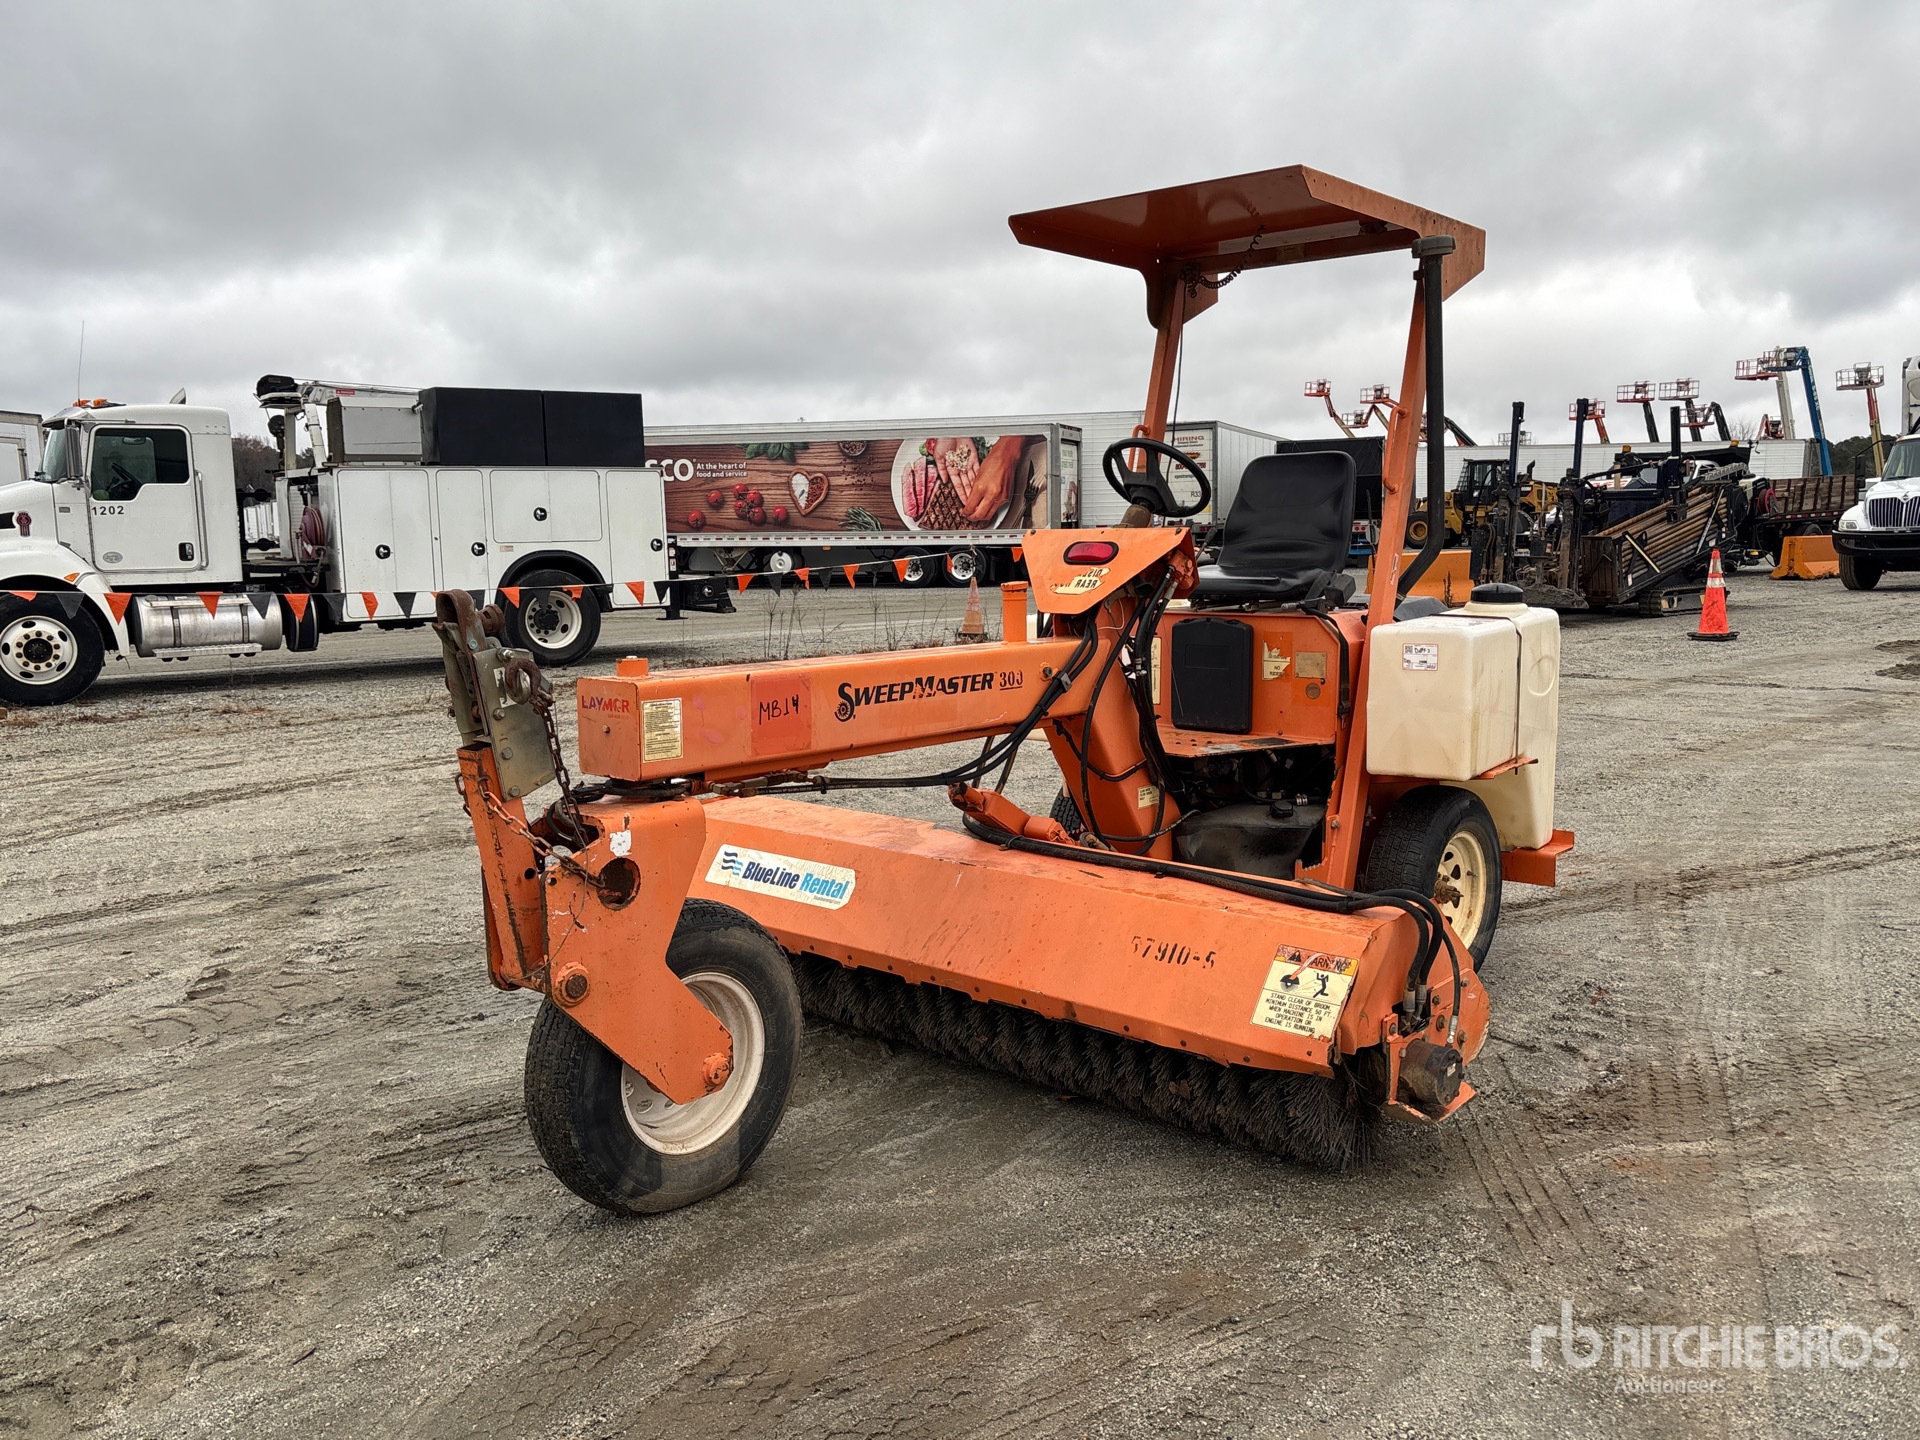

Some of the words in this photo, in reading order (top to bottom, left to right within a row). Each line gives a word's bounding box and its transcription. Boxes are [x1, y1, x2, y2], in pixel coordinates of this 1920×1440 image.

[718, 462, 738, 470] heart
[739, 461, 747, 469] of
[91, 505, 125, 516] 1202
[742, 861, 800, 889] BlueLine
[799, 872, 850, 899] Rental
[1270, 992, 1287, 1001] STAND
[1288, 995, 1304, 1004] CLEAR
[1305, 998, 1312, 1006] OF
[1265, 998, 1287, 1008] MINIMUM
[1288, 1002, 1313, 1013] DISTANCE
[1315, 1007, 1322, 1016] 50
[1269, 1005, 1282, 1013] WHEN
[1283, 1008, 1305, 1019] MACHINE
[1307, 1012, 1314, 1020] IS
[1316, 1014, 1323, 1022] IN
[1265, 1017, 1283, 1027] ENGINE
[1285, 1020, 1292, 1028] IS
[1293, 1022, 1316, 1034] RUNNING
[1275, 1013, 1303, 1025] OPERATION
[1304, 1018, 1312, 1026] OR
